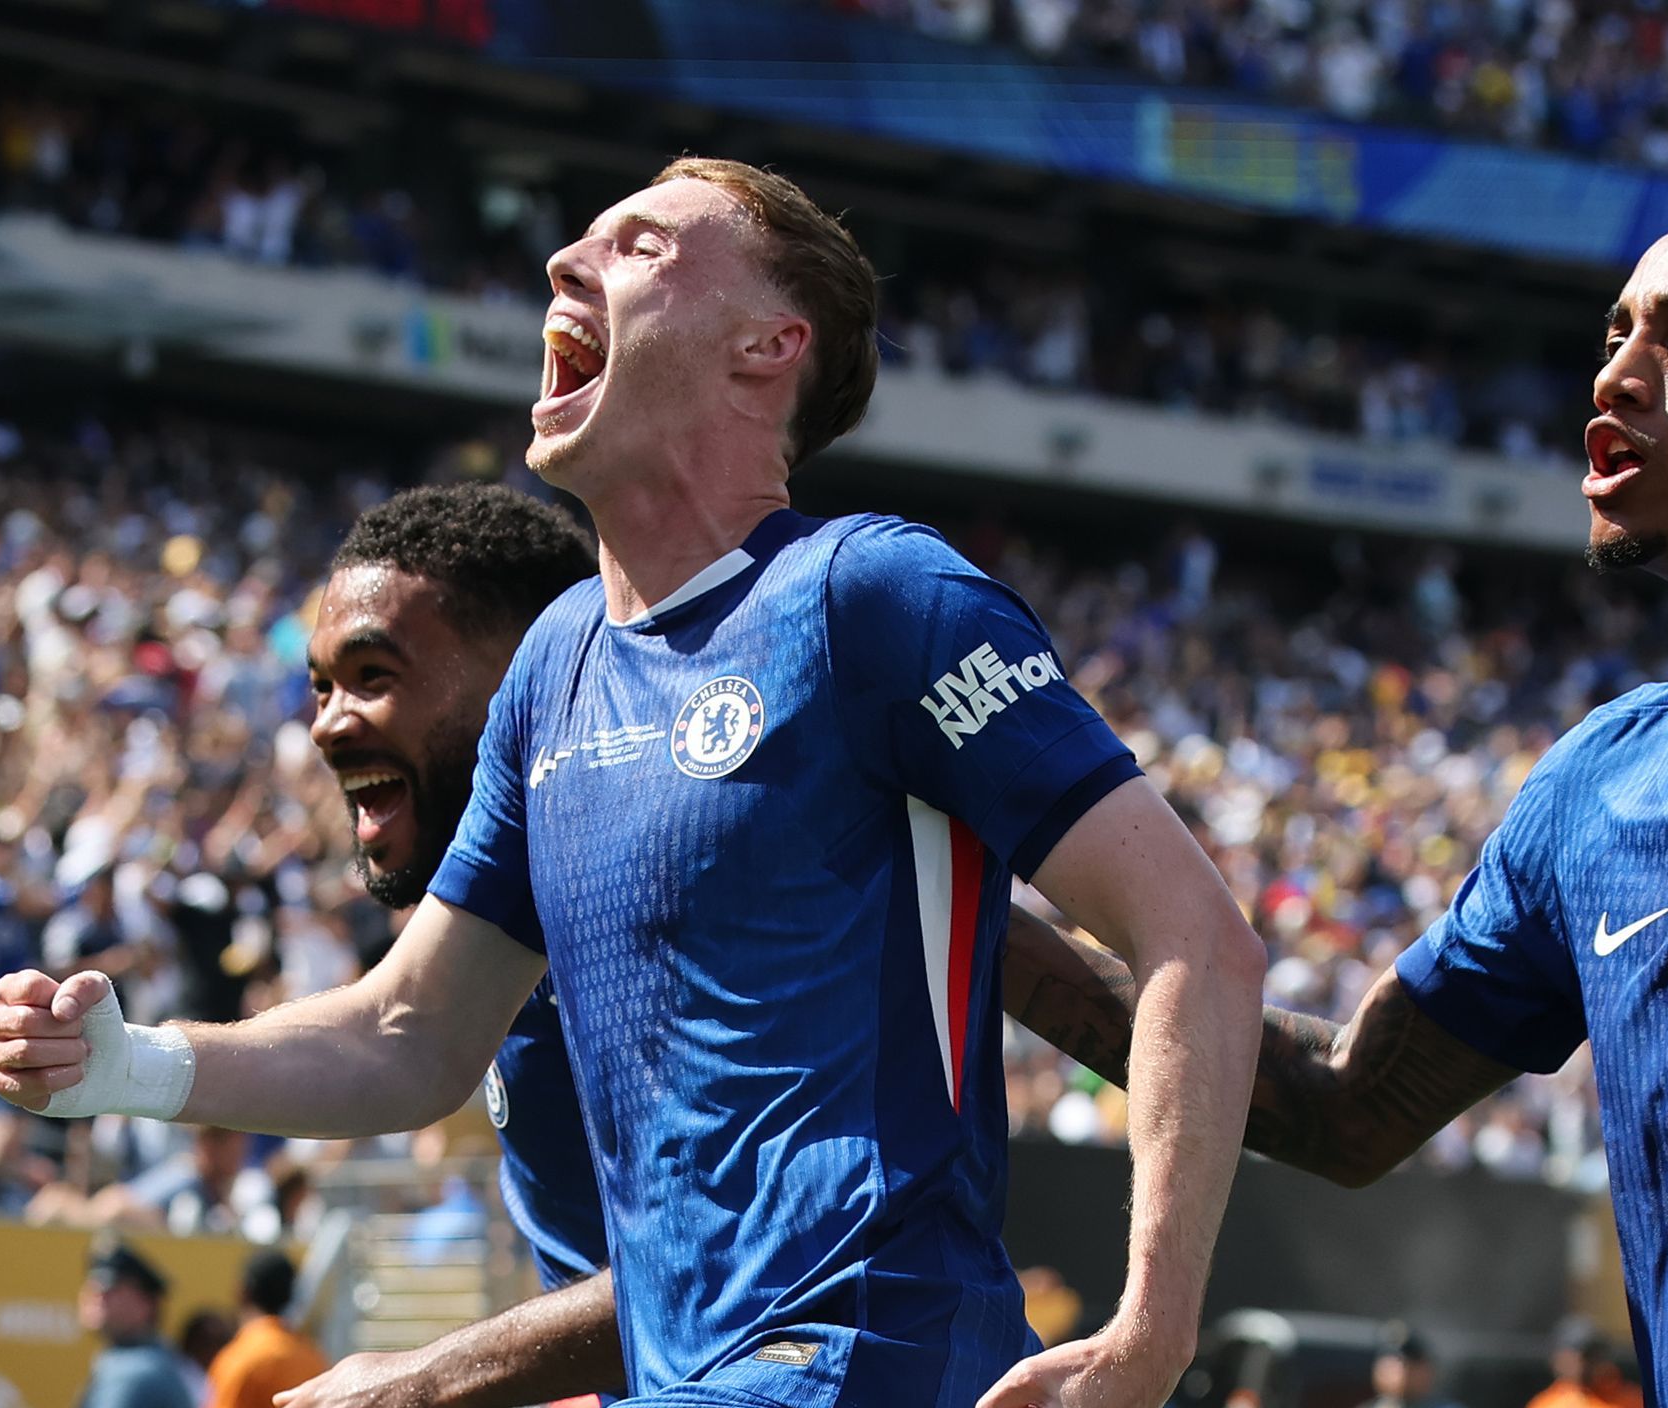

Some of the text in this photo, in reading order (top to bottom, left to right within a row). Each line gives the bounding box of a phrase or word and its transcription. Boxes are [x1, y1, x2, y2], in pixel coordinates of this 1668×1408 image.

[691, 680, 748, 709] CHELSEA
[920, 642, 1006, 724] LIVE
[939, 651, 1064, 750] NATION
[683, 748, 747, 774] FOOTBALL CLUB
